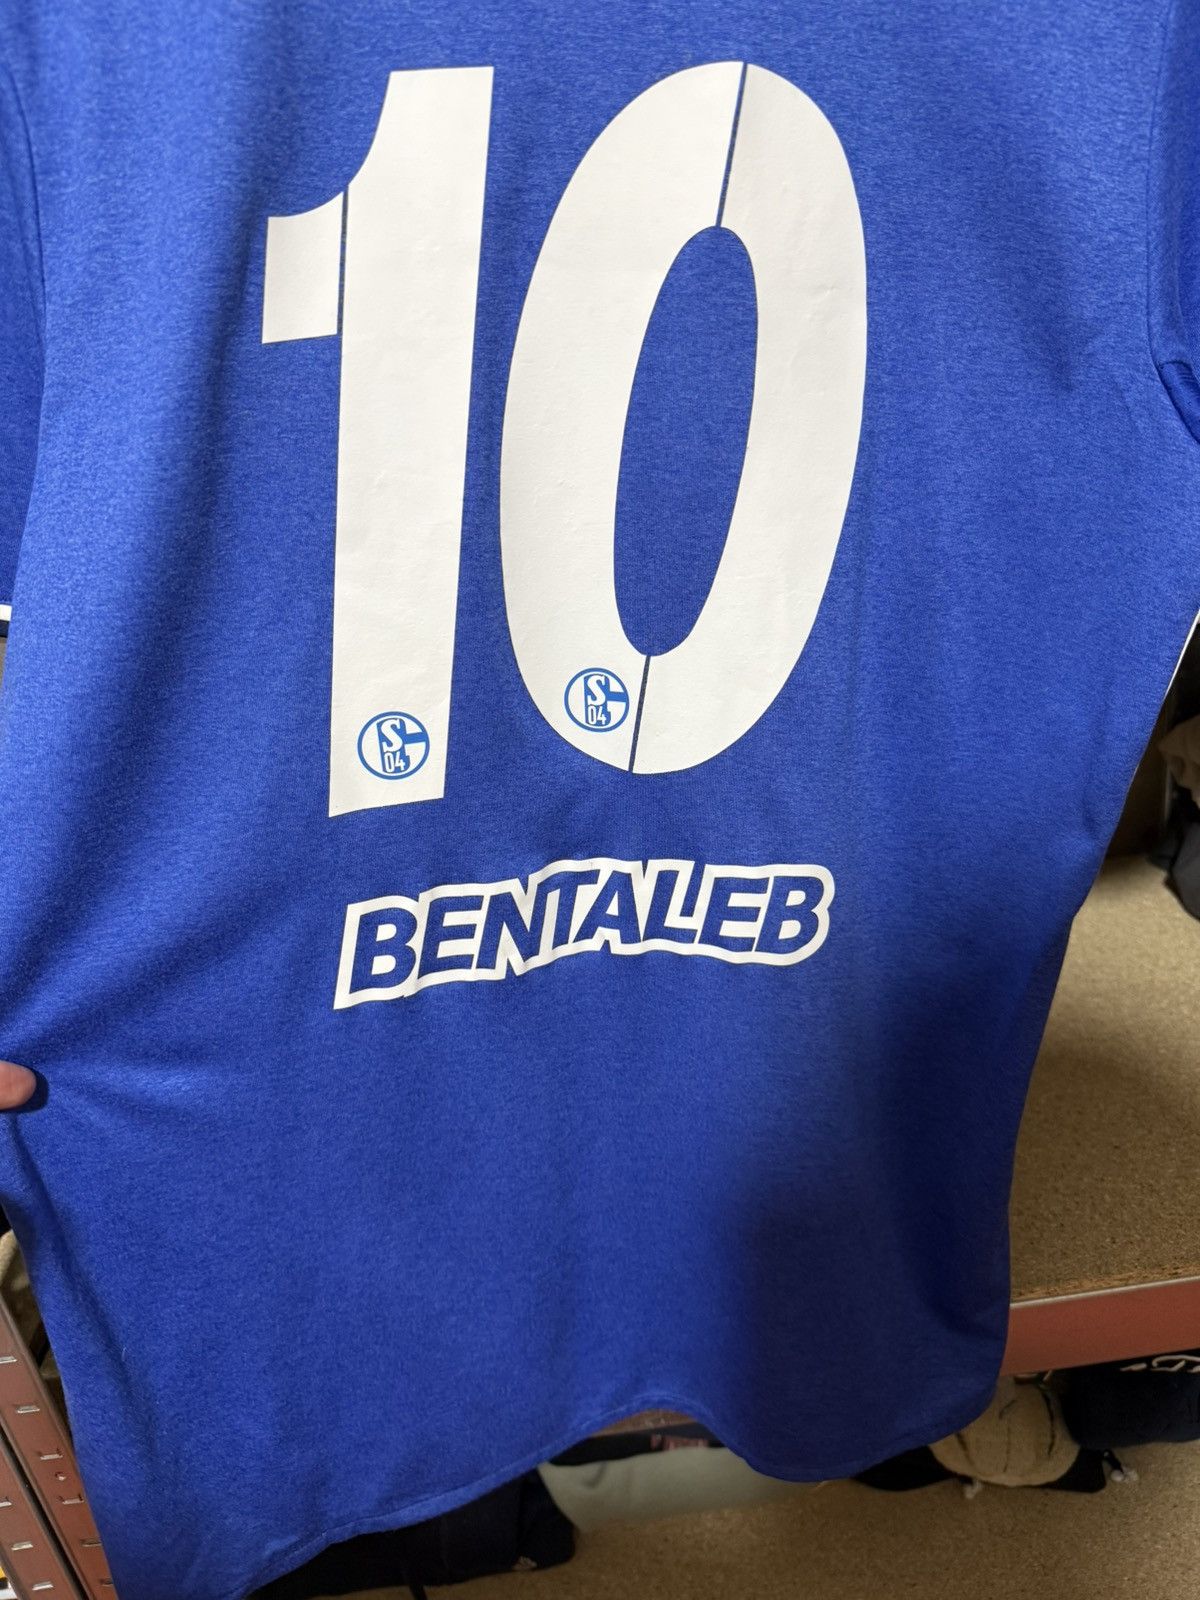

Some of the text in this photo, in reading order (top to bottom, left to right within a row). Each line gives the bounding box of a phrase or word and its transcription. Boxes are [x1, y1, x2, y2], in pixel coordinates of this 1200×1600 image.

[262, 61, 867, 817] 10
[587, 675, 606, 706] S
[588, 705, 607, 725] 04
[380, 718, 403, 753] S
[384, 751, 406, 773] 04
[333, 857, 836, 1010] BENTALEB
